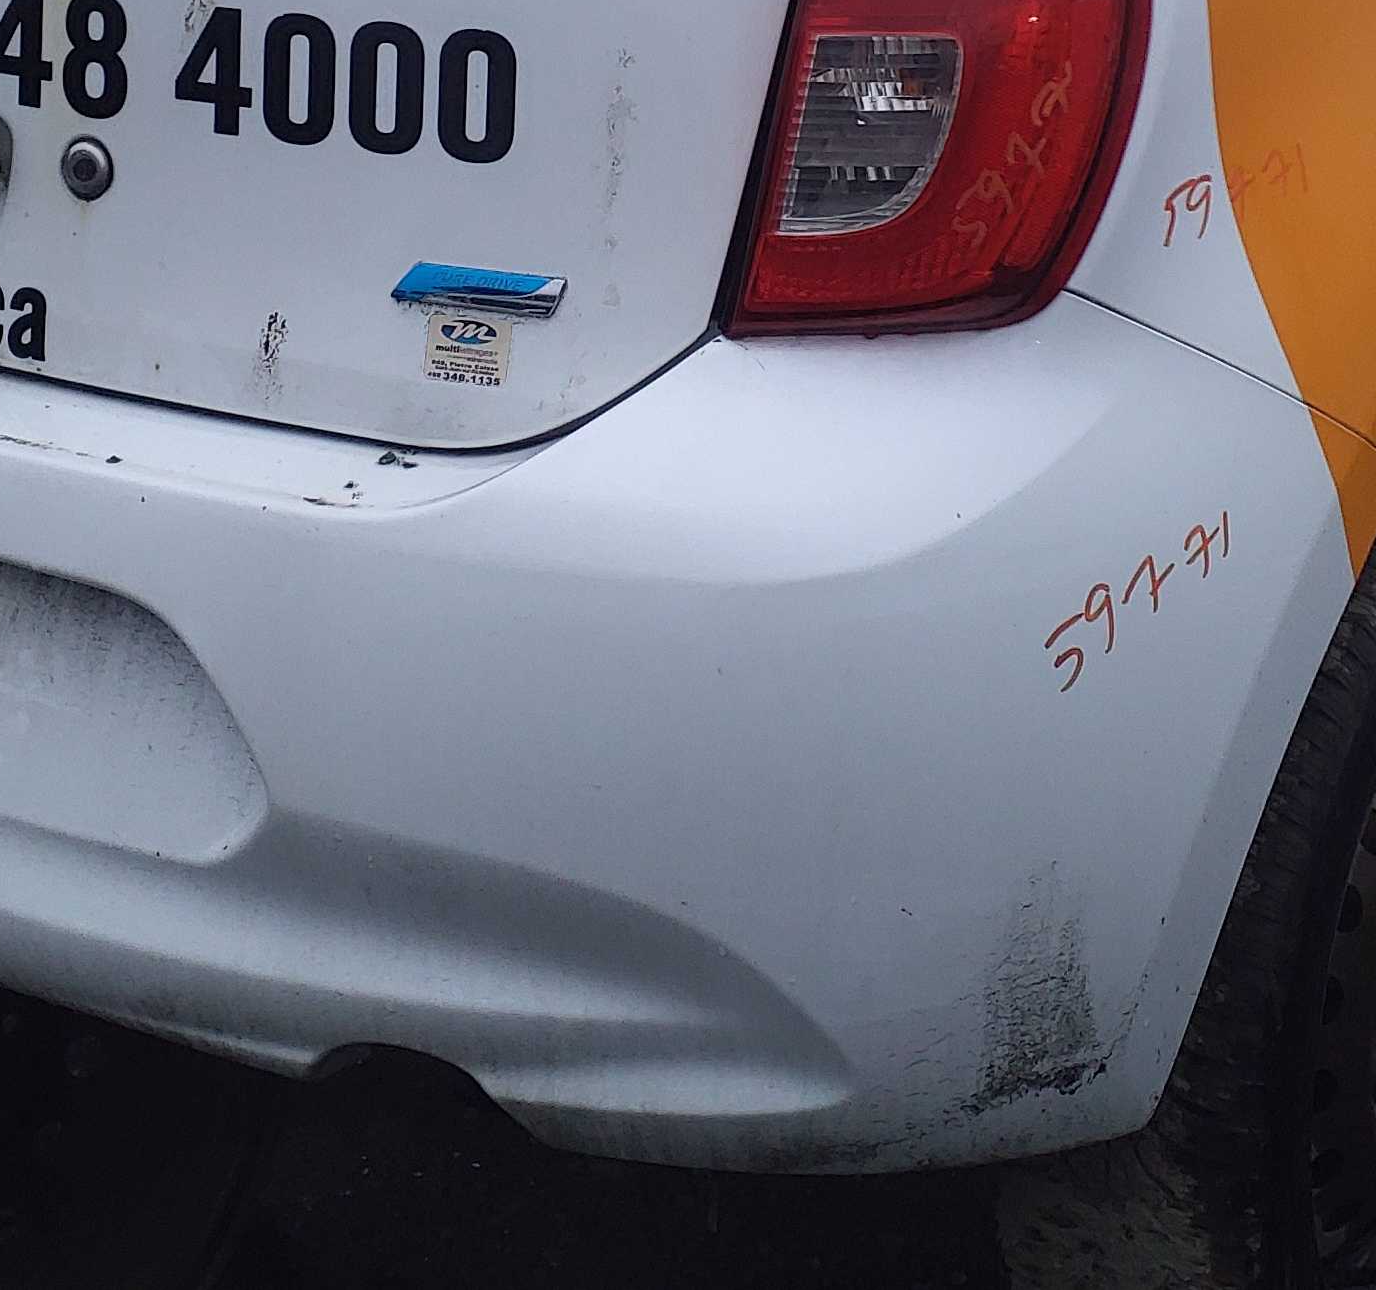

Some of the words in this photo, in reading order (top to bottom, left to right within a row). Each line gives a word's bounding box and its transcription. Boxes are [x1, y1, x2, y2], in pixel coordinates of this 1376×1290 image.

[174, 6, 517, 164] 4000
[432, 269, 474, 286] PURE
[476, 276, 525, 291] DRIVE
